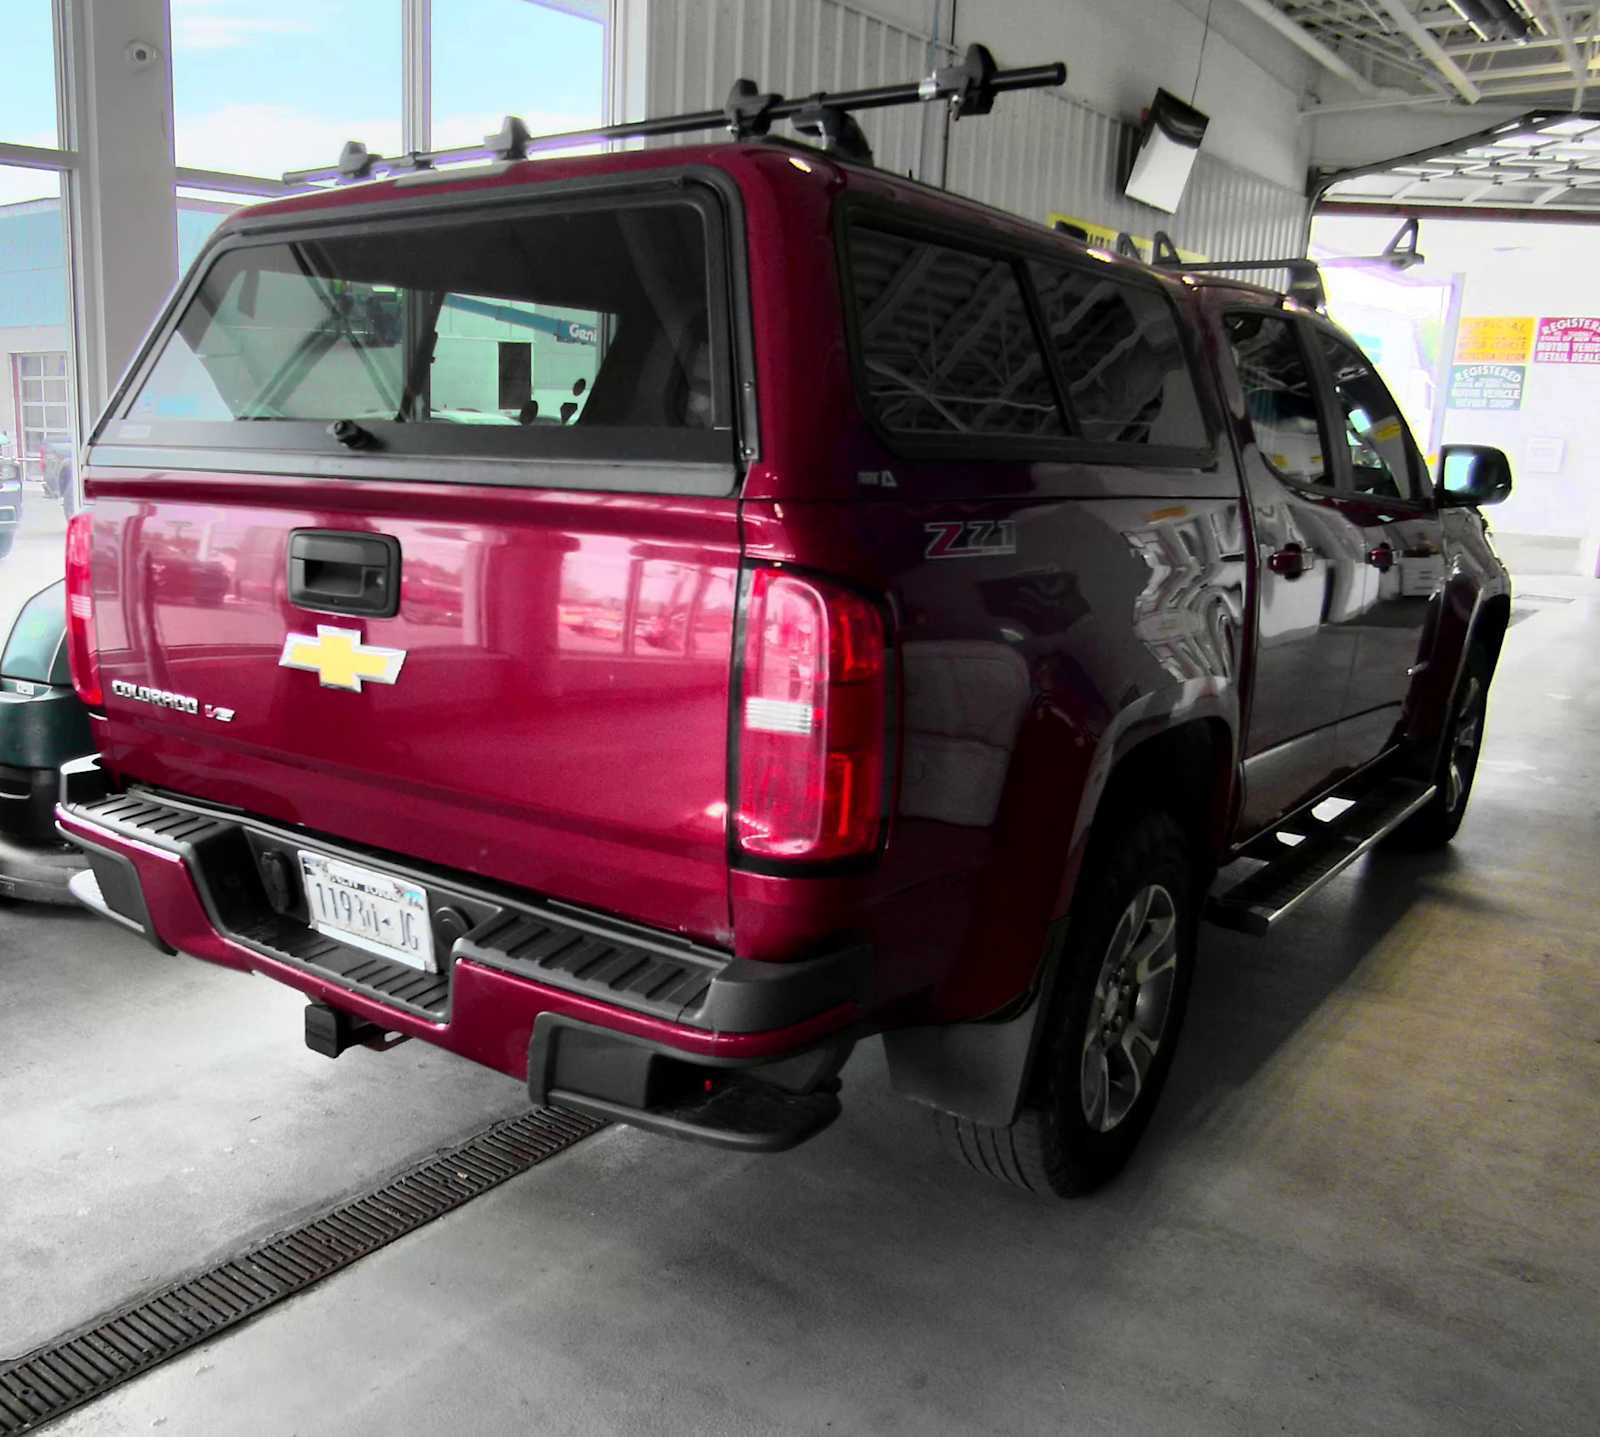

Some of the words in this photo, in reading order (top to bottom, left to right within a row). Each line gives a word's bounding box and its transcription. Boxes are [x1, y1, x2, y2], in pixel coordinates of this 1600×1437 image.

[1455, 365, 1521, 385] REGISTERED
[925, 520, 1017, 559] Z71
[112, 680, 199, 714] COLORADO
[204, 704, 236, 722] V6
